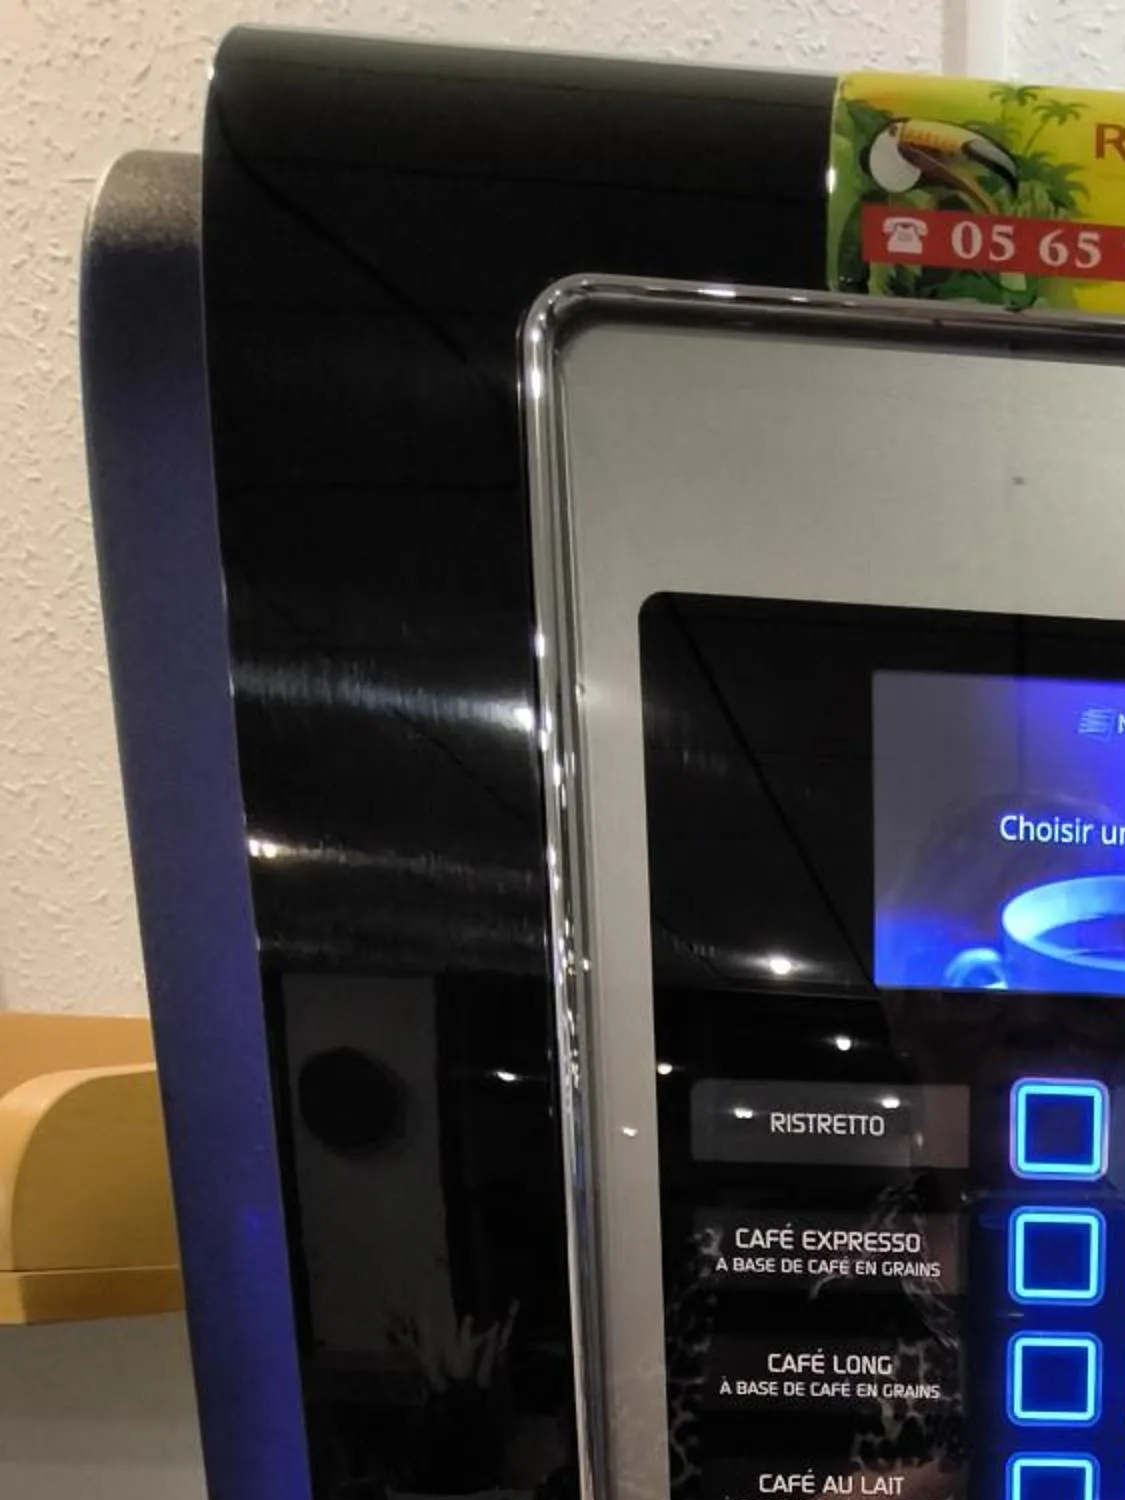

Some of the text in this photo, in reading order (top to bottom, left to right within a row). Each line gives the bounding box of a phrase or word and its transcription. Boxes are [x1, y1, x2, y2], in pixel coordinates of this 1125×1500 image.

[951, 219, 1016, 262] 05
[1038, 228, 1101, 269] 65
[999, 814, 1093, 845] Choisir
[770, 1111, 886, 1137] RISTRETTO
[734, 1221, 921, 1253] CAFÉ EXPRESSO
[733, 1257, 777, 1273] BASE
[781, 1258, 803, 1274] DE
[855, 1261, 877, 1276] EN
[881, 1261, 941, 1278] GRAINS
[767, 1347, 893, 1376] CAFÉ LONG
[736, 1381, 778, 1397] BASE
[782, 1382, 805, 1397] DE
[857, 1383, 878, 1398] EN
[882, 1383, 941, 1400] GRAINS
[758, 1468, 904, 1497] CAFÉ AU LAIT
